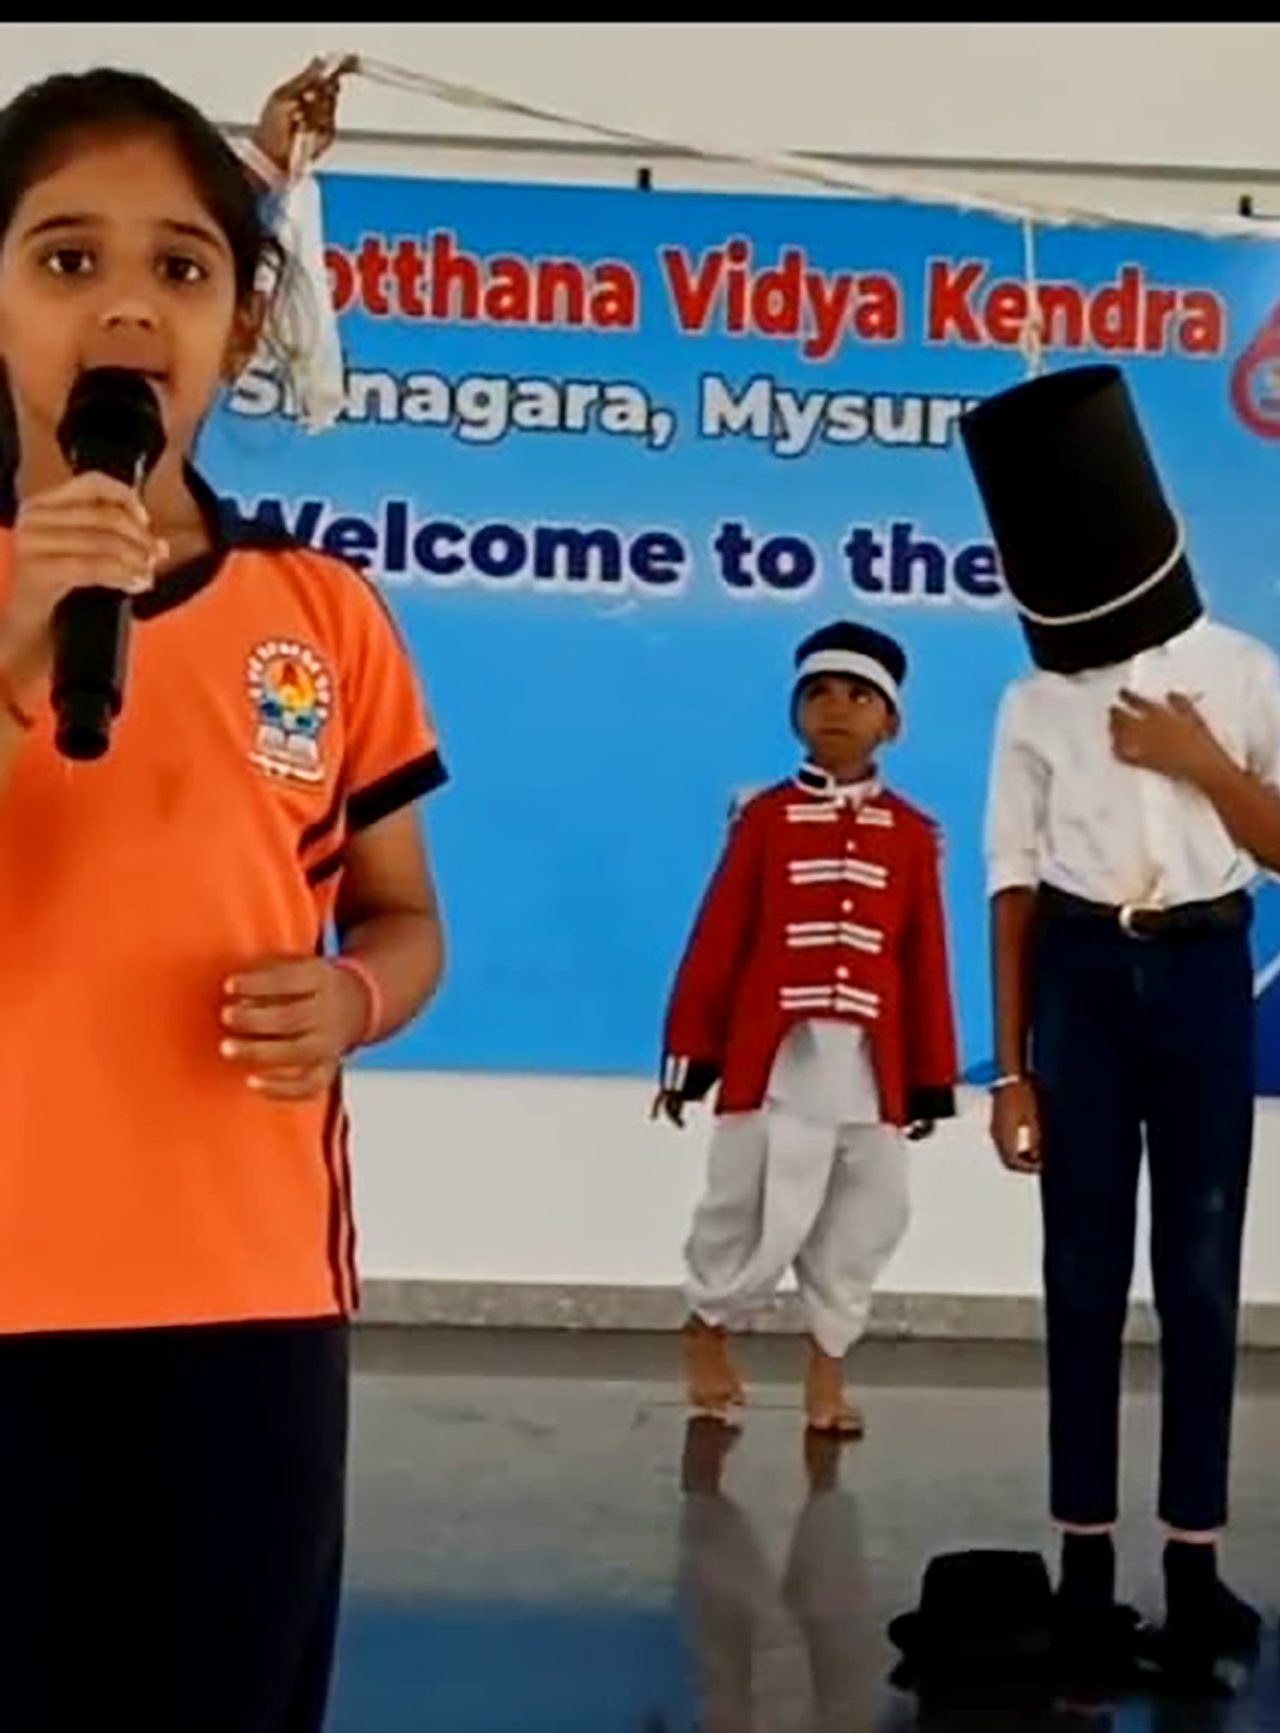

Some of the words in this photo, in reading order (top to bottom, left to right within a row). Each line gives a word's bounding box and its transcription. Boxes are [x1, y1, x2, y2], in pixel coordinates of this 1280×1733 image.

[661, 239, 899, 360] Vidya
[927, 260, 1223, 353] Kendra
[228, 366, 675, 449] Snagara,
[701, 372, 978, 456] Mysur
[713, 523, 816, 590] to
[844, 522, 1003, 596] the
